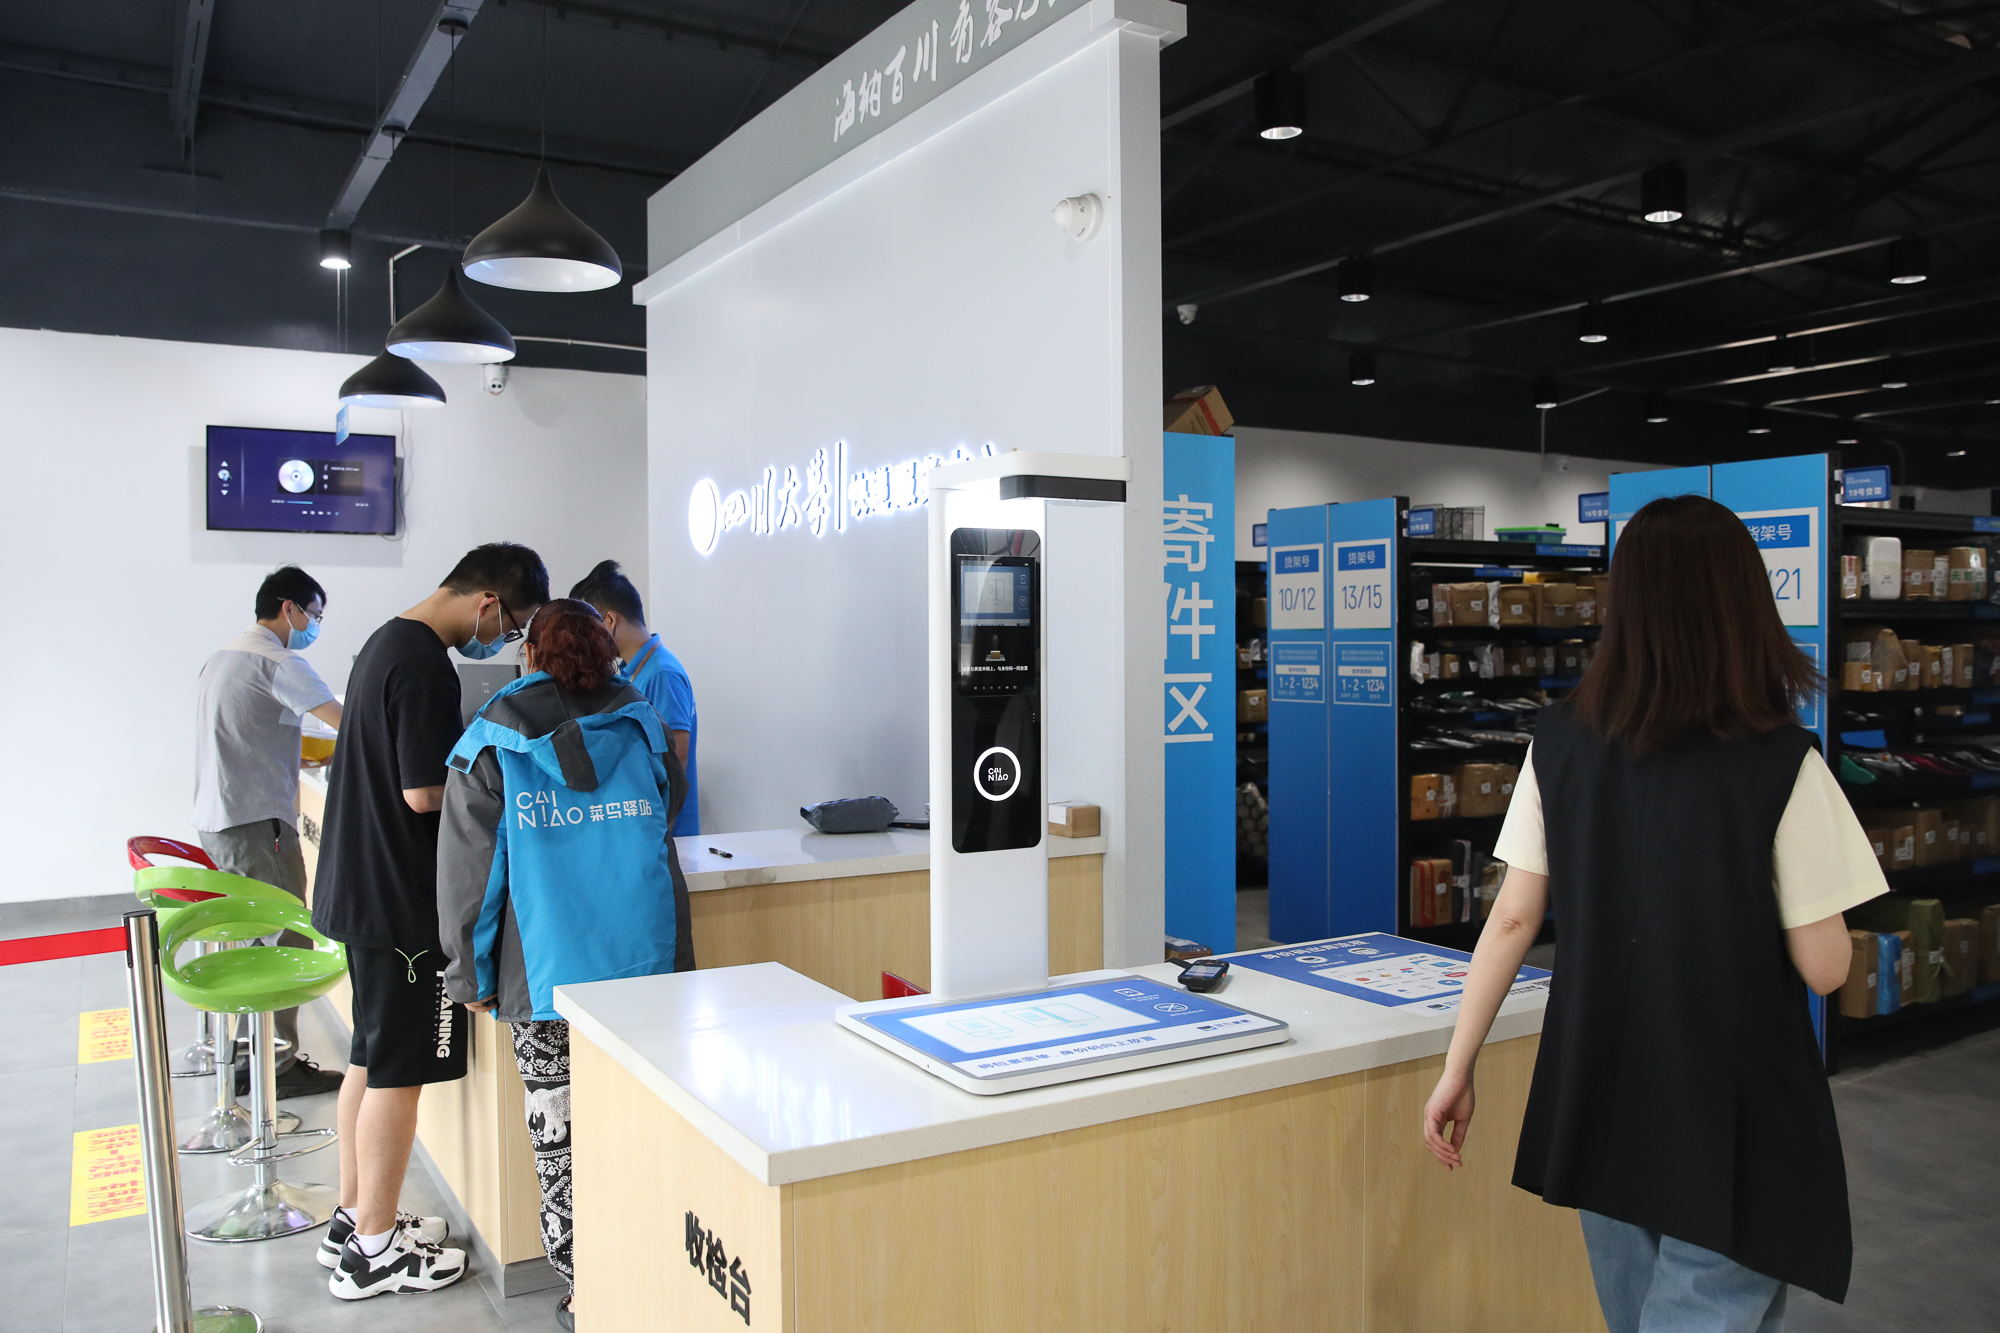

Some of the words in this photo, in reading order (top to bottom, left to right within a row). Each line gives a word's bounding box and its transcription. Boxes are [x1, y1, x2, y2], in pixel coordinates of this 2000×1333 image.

[833, 0, 1055, 142] 海纳百川有容
[1748, 523, 1793, 542] 货架号
[1284, 554, 1310, 570] 货架号
[1347, 550, 1376, 566] 货架号
[1767, 567, 1802, 601] 21
[1278, 587, 1316, 611] 10/12
[1341, 584, 1382, 610] 13/15
[987, 767, 1002, 775] CAI
[516, 790, 557, 810] CAI
[589, 799, 653, 822] 菜鸟驿站
